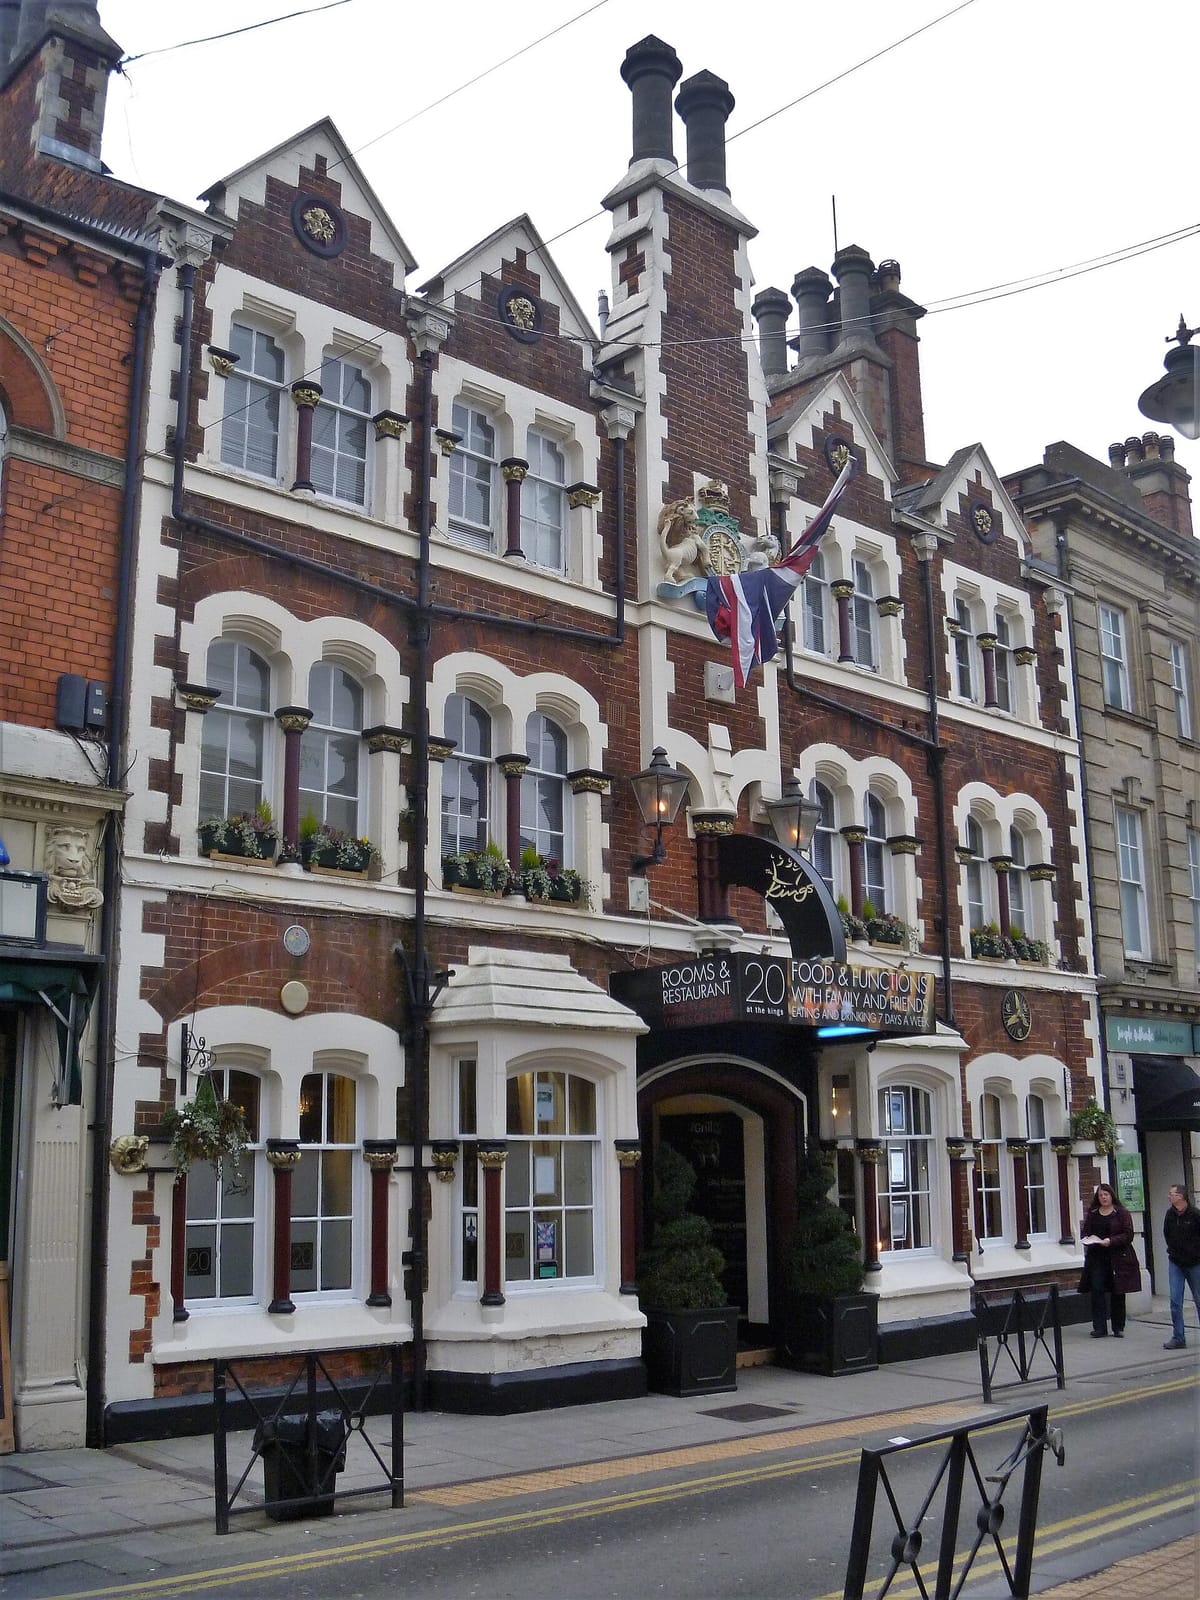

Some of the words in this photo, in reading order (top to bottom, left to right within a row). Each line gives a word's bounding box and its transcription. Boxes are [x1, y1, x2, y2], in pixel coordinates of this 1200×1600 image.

[661, 963, 715, 989] ROOMS
[719, 960, 731, 979] &
[745, 962, 785, 1005] 20
[791, 961, 835, 985] FOOD
[838, 966, 849, 987] &
[852, 970, 928, 995] FUNCTIONS
[662, 980, 732, 1005] RESTAURANT
[791, 986, 822, 1004] WITH
[825, 989, 860, 1008] FAMILY
[862, 994, 887, 1010] AND
[889, 996, 929, 1014] FRIENDS
[755, 1006, 765, 1014] the
[767, 1007, 784, 1017] kings
[792, 1007, 820, 1019] EATING
[821, 1009, 840, 1020] AND
[841, 1011, 877, 1024] DRINKING
[878, 1013, 883, 1023] 7
[885, 1014, 902, 1026] DAYS
[903, 1015, 909, 1025] A
[909, 1016, 930, 1028] WEEK
[189, 1251, 211, 1271] 20
